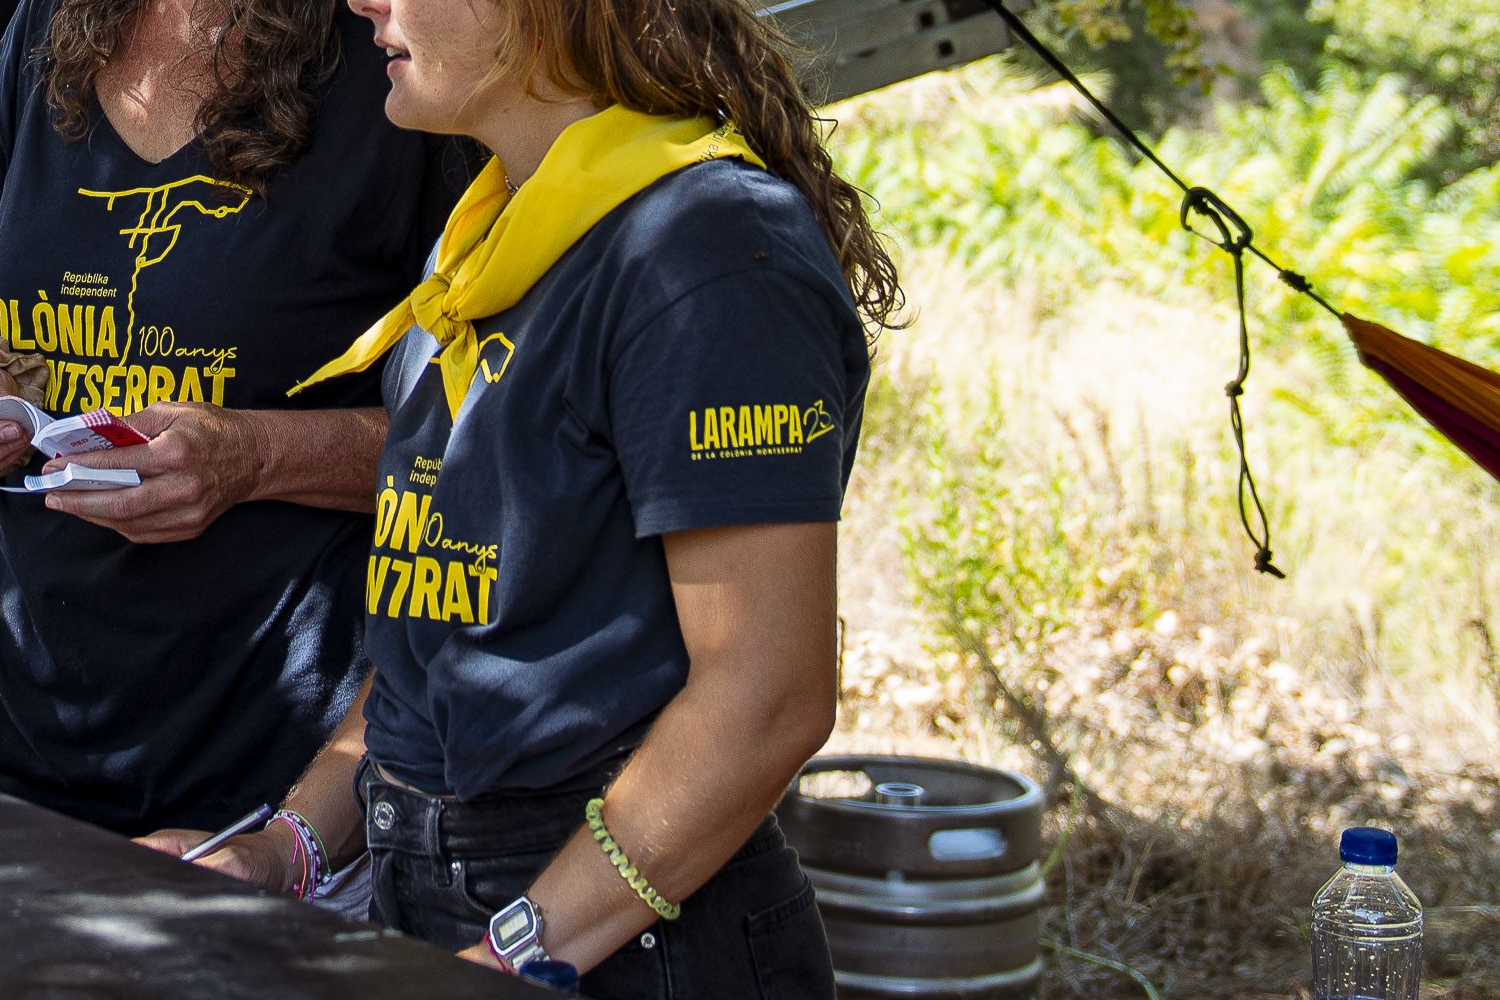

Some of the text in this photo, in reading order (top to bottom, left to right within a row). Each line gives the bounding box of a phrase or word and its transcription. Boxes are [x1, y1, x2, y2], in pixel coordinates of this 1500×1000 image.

[60, 283, 117, 298] independent
[62, 271, 109, 285] Repúblika
[138, 325, 238, 374] 100 anys
[44, 358, 236, 417] NTSERRAT
[689, 404, 804, 451] LARAMPA
[414, 455, 443, 472] Repúb
[705, 451, 716, 459] LA
[756, 446, 803, 456] MONTSERRAT
[442, 537, 498, 575] anys
